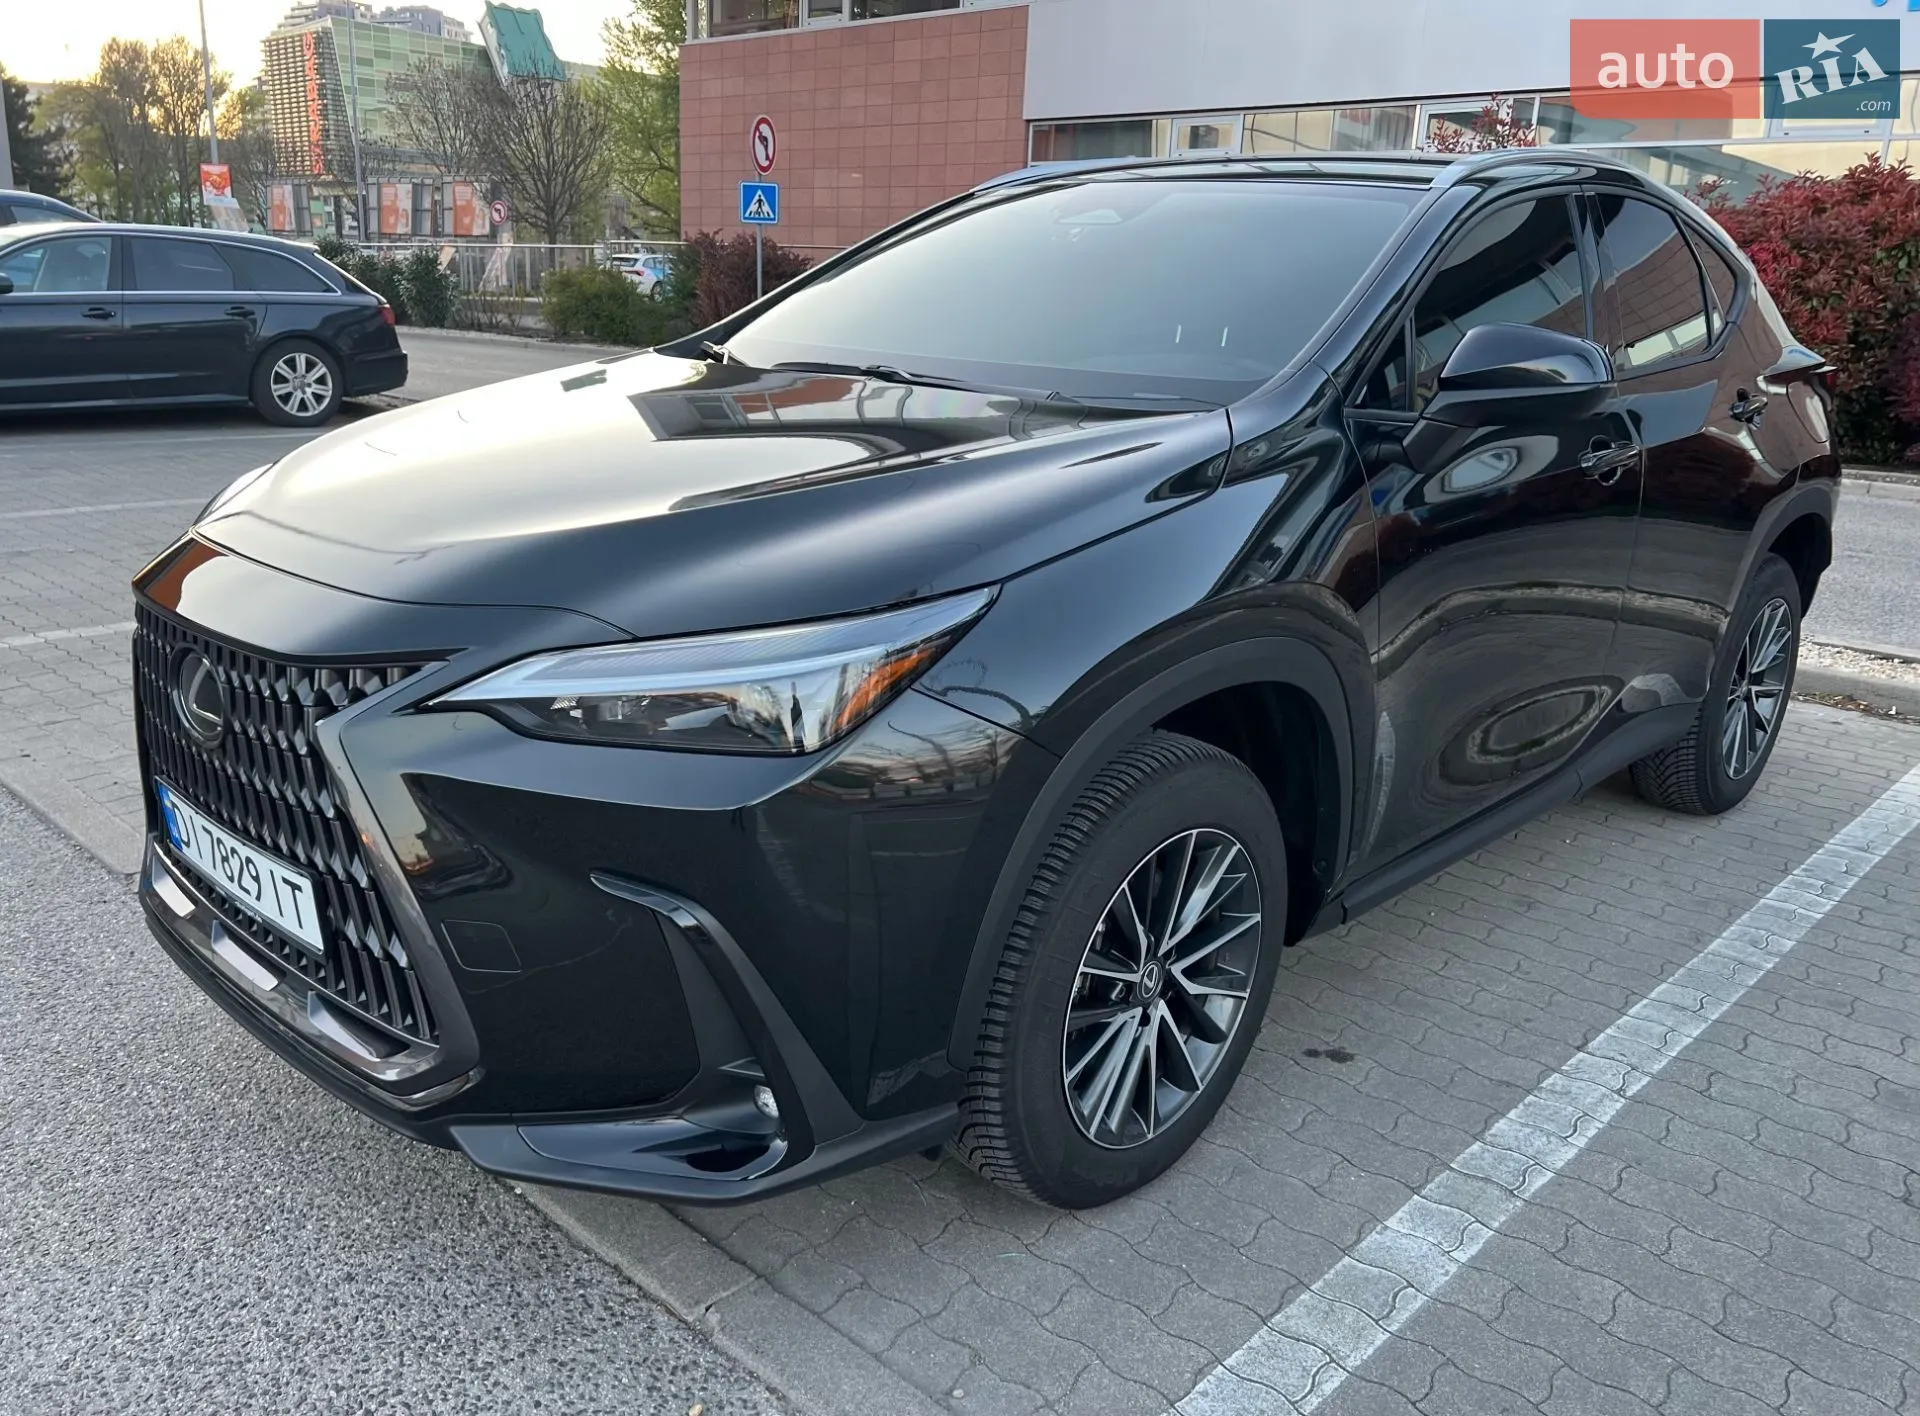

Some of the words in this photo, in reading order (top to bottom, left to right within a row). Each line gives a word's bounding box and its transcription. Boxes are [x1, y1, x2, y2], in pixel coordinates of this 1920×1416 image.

[303, 31, 323, 174] STRABAG
[171, 800, 203, 860] DI
[201, 824, 262, 903] 7829
[269, 869, 304, 930] IT
